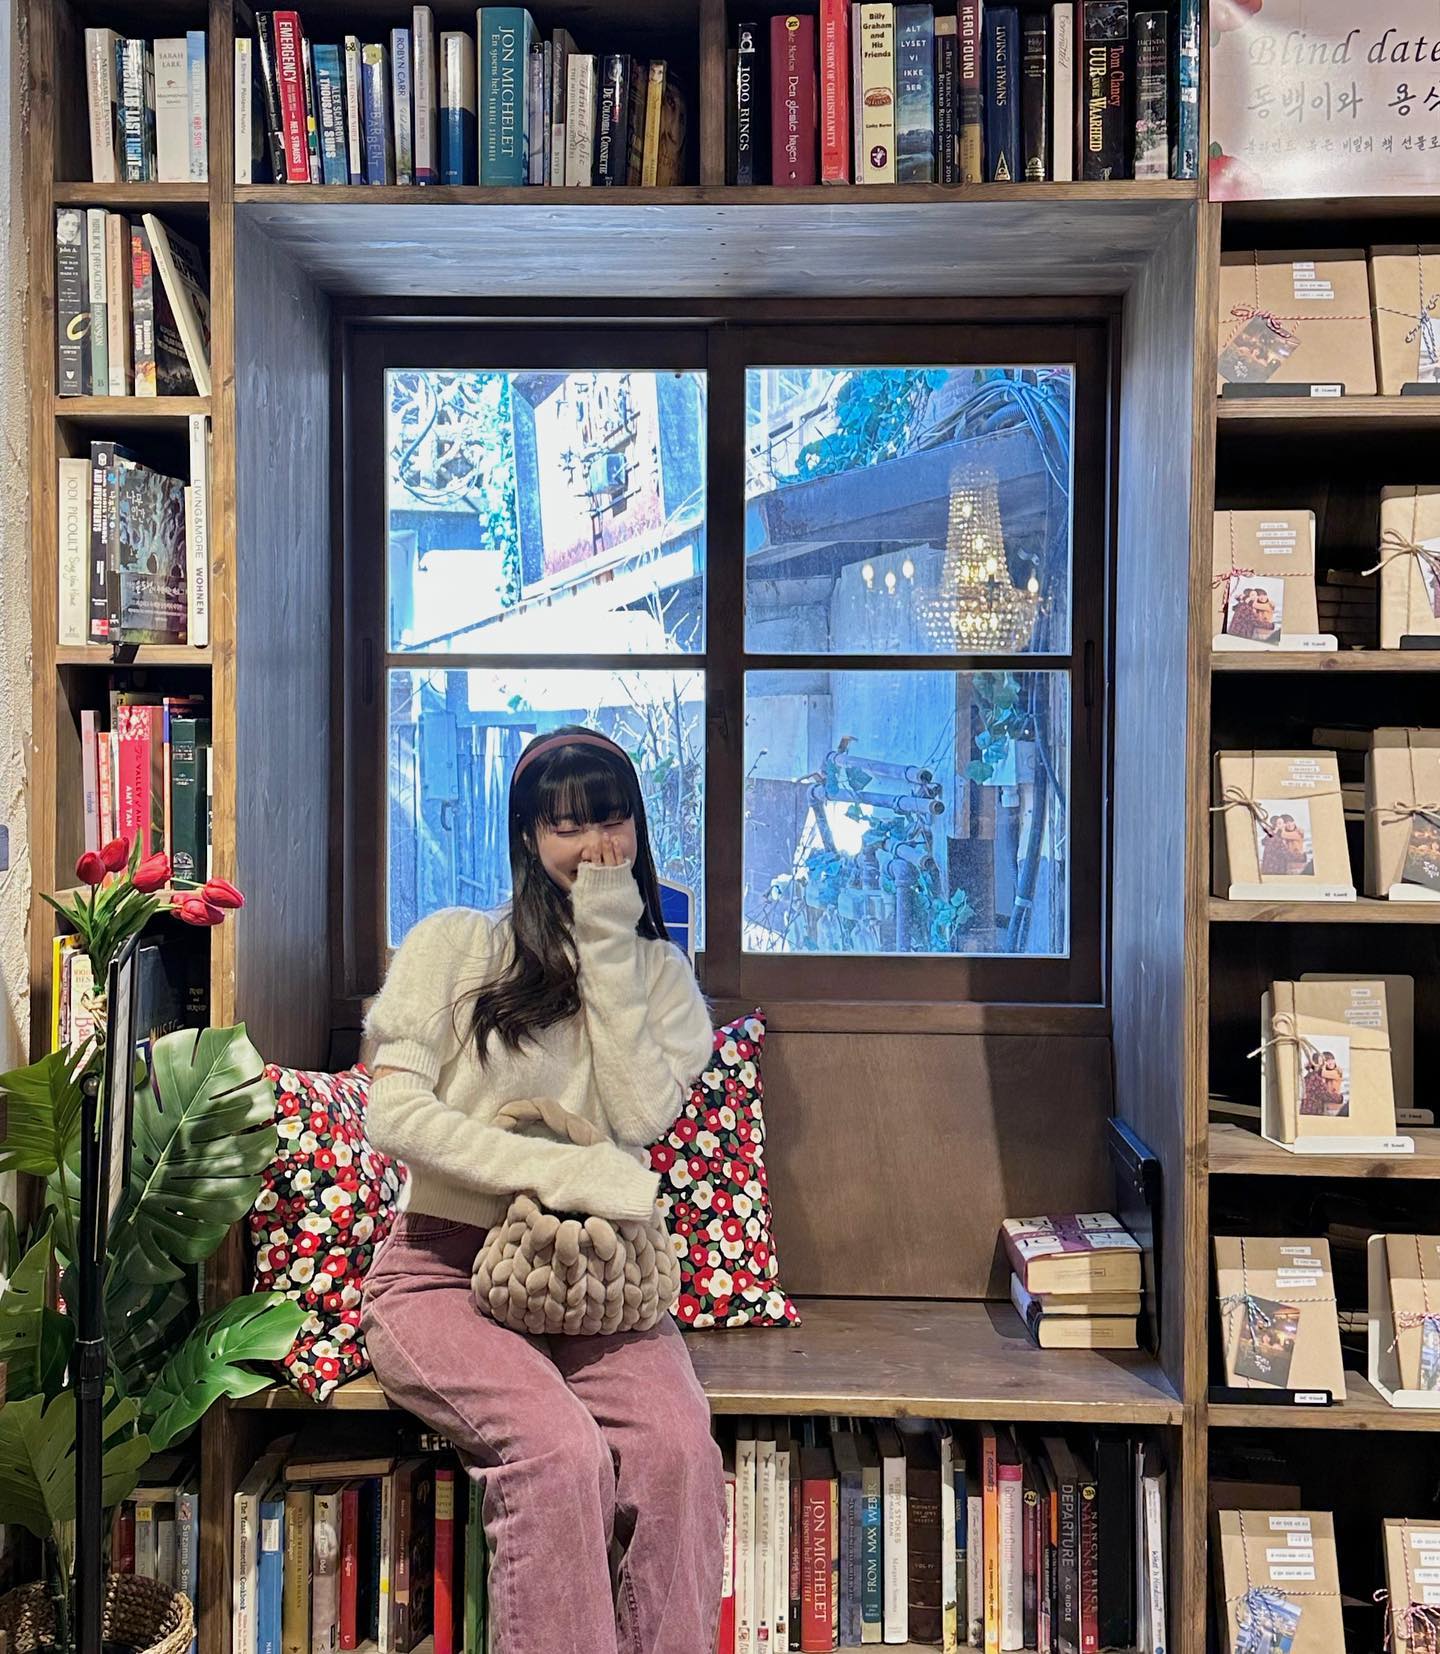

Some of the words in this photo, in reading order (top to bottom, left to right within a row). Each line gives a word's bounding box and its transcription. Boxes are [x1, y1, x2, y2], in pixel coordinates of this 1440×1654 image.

[827, 20, 835, 41] THE
[863, 22, 892, 30] Graham
[905, 25, 921, 33] ALT
[962, 6, 974, 37] HERO
[279, 21, 297, 83] EMERGENCY
[397, 37, 405, 69] ROBYN
[491, 34, 500, 46] En
[498, 26, 515, 61] JON
[827, 42, 835, 69] STORY
[864, 51, 891, 59] Friends
[872, 41, 883, 49] His
[996, 26, 1006, 62] LIVING
[1057, 15, 1071, 69] Committed
[1249, 28, 1361, 66] Blind
[159, 52, 184, 60] SARAH
[909, 54, 919, 62] VI
[962, 39, 974, 79] FOUND
[1088, 46, 1107, 77] UUR
[1110, 45, 1124, 68] Tom
[397, 71, 406, 96] CARR
[491, 78, 500, 94] helt
[739, 66, 750, 102] 1000
[789, 76, 798, 97] Den
[827, 70, 835, 81] OF
[996, 65, 1006, 106] HYMNS
[1108, 70, 1125, 107] Clancy
[319, 78, 332, 127] THOUSAND
[331, 85, 341, 104] ALEX
[1248, 81, 1363, 122] 동백이와
[126, 110, 140, 134] LAST
[290, 120, 299, 134] NEIL
[333, 106, 344, 143] SCARROW
[501, 68, 514, 158] MICHELET
[785, 100, 798, 132] glemte
[827, 82, 835, 148] CHRISTIANITY
[1089, 96, 1108, 152] WAARHEID
[324, 131, 337, 158] SUNS
[739, 107, 750, 151] RINGS
[1342, 136, 1373, 153] 비밀의
[1381, 135, 1393, 153] 책
[126, 138, 142, 167] LIGHT
[291, 136, 302, 164] STRAUSS
[574, 131, 591, 166] Relic
[786, 134, 799, 163] hagen
[945, 134, 953, 163] STORIES
[90, 252, 103, 300] PREACHING
[136, 324, 144, 351] Lewis
[143, 320, 152, 355] Damien
[67, 476, 79, 500] JODI
[92, 484, 102, 532] INVESTMENTS
[193, 479, 204, 559] LIVING&MORE
[67, 506, 79, 553] PICOULT
[195, 567, 205, 615] WOHNEN
[125, 786, 133, 805] AMY
[125, 808, 133, 827] TAN
[986, 1458, 995, 1492] Espresso
[240, 1501, 248, 1514] The
[804, 1505, 811, 1517] En
[867, 1483, 877, 1522] WEBER
[1004, 1486, 1015, 1510] Good
[240, 1516, 248, 1534] Yeast
[810, 1498, 826, 1532] JON
[1004, 1512, 1015, 1535] Word
[1061, 1484, 1076, 1566] DEPARTURE
[180, 1524, 190, 1565] Suzanne
[867, 1527, 877, 1553] MAX
[1081, 1500, 1092, 1566] NATTENS
[1090, 1511, 1099, 1560] NANCY
[239, 1536, 248, 1575] Connection
[804, 1547, 812, 1563] helt
[1004, 1538, 1015, 1564] Guide
[813, 1537, 827, 1622] MICHELET
[867, 1559, 877, 1592] FROM
[1064, 1576, 1072, 1592] A.G.
[239, 1576, 248, 1611] Cookbook
[1082, 1570, 1092, 1621] KVINNE
[1090, 1569, 1099, 1614] PRICE
[1064, 1594, 1072, 1622] RIDDLE
